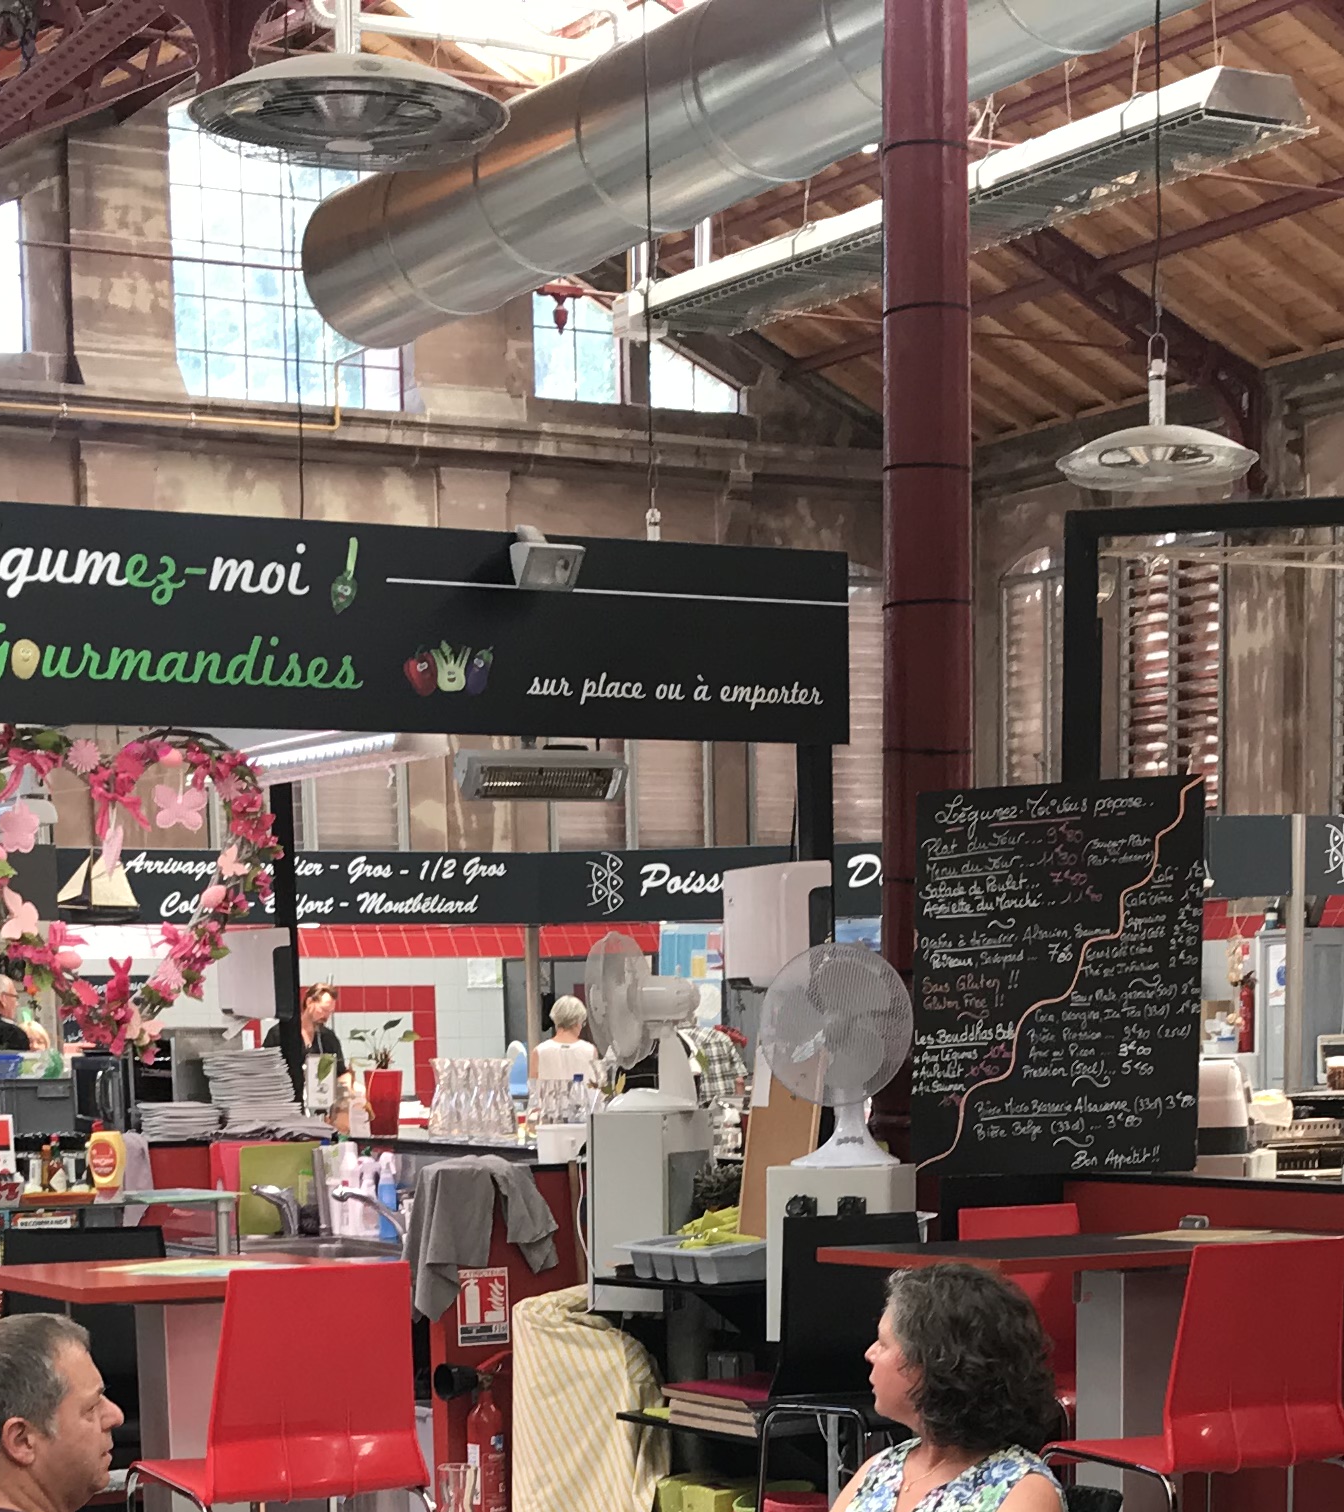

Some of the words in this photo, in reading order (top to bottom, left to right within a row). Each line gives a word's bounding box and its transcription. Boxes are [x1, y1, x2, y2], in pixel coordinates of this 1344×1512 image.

[526, 674, 572, 697] sur
[580, 670, 647, 703] place
[654, 682, 686, 700] ou
[692, 671, 710, 702] à
[718, 675, 825, 710] emporter
[921, 837, 957, 857] Plat
[967, 838, 988, 852] du
[125, 851, 217, 881] Arrivage
[347, 857, 393, 880] Gros
[418, 858, 457, 880] 1/2
[463, 857, 508, 880] Gros
[926, 863, 958, 881] Menu
[961, 860, 983, 873] du
[357, 892, 478, 917] Montbéliard
[1071, 1150, 1098, 1170] Bon
